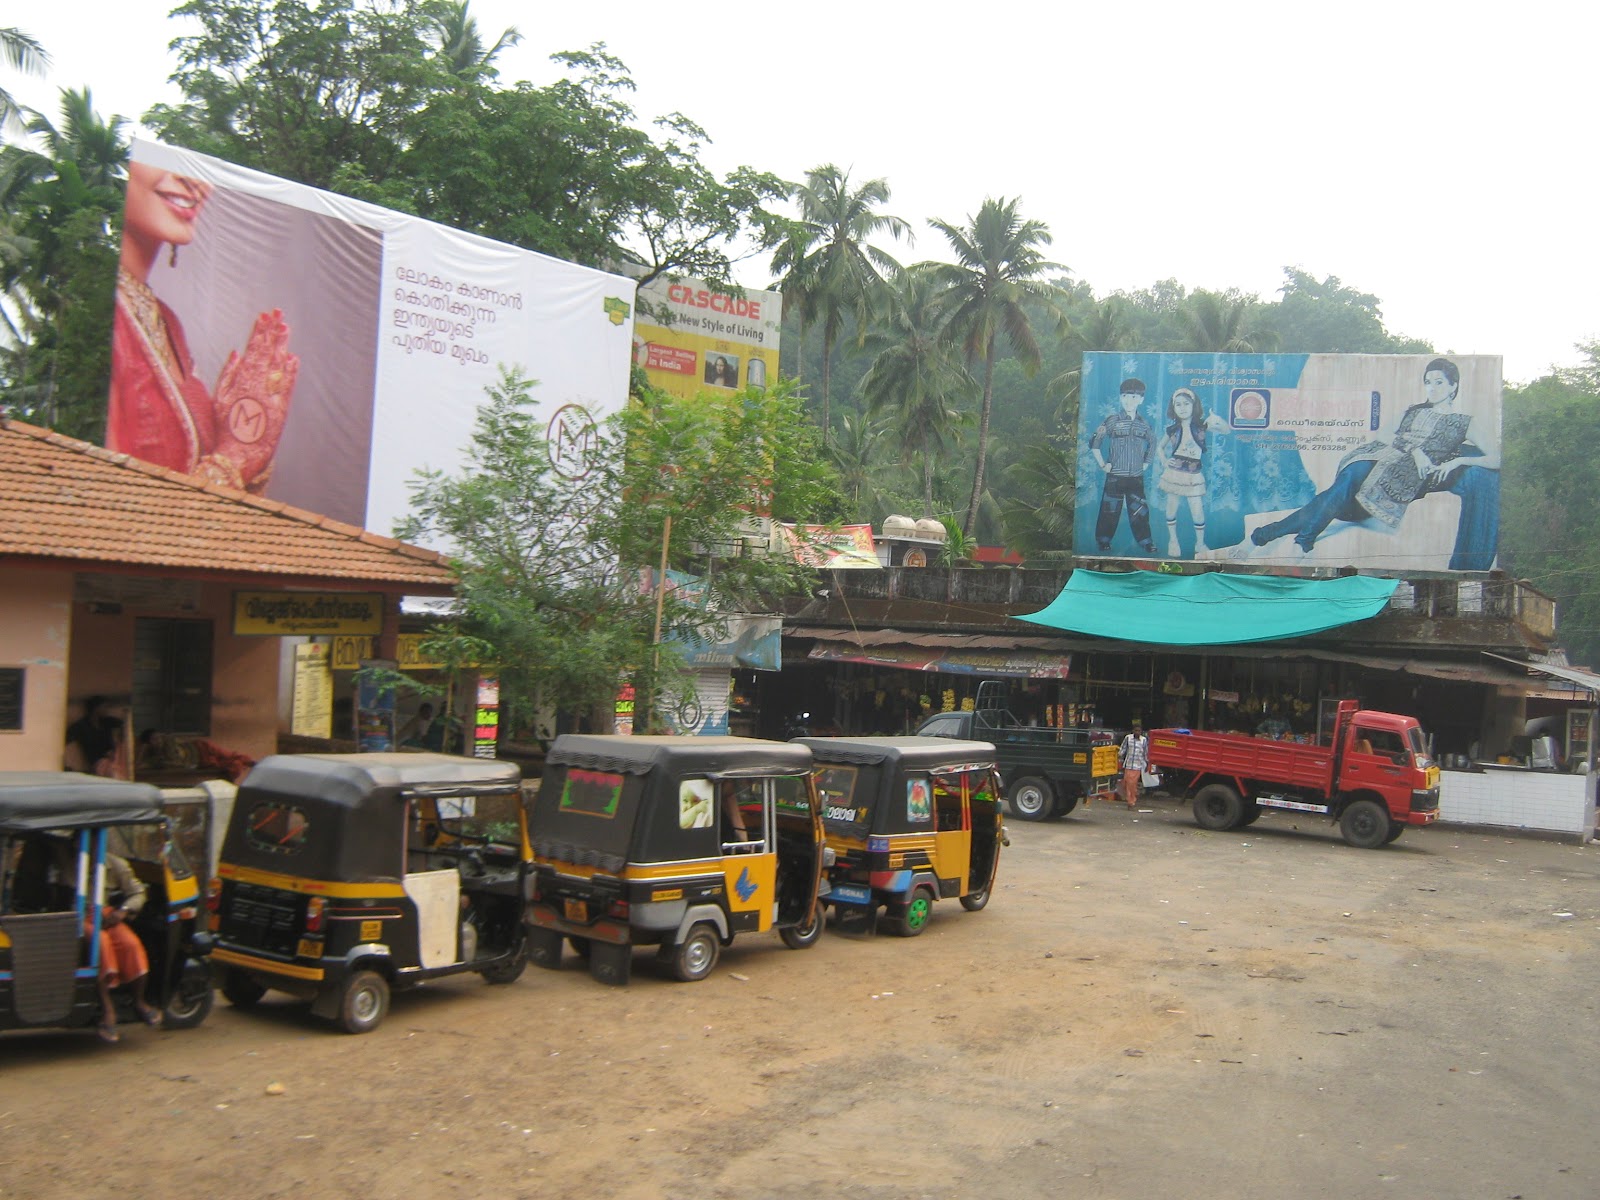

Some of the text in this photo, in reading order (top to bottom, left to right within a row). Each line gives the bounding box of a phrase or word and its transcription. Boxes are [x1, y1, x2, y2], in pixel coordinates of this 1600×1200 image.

[396, 266, 523, 310] ലോകം കാണാൻ
[667, 284, 761, 320] CASCADE
[394, 288, 496, 325] കൊതിക്കുന്ന
[679, 313, 700, 328] New
[701, 317, 725, 333] Style
[726, 324, 736, 334] of
[737, 325, 764, 342] Living
[392, 334, 489, 366] പുതിയ മുഖം
[659, 358, 682, 371] India
